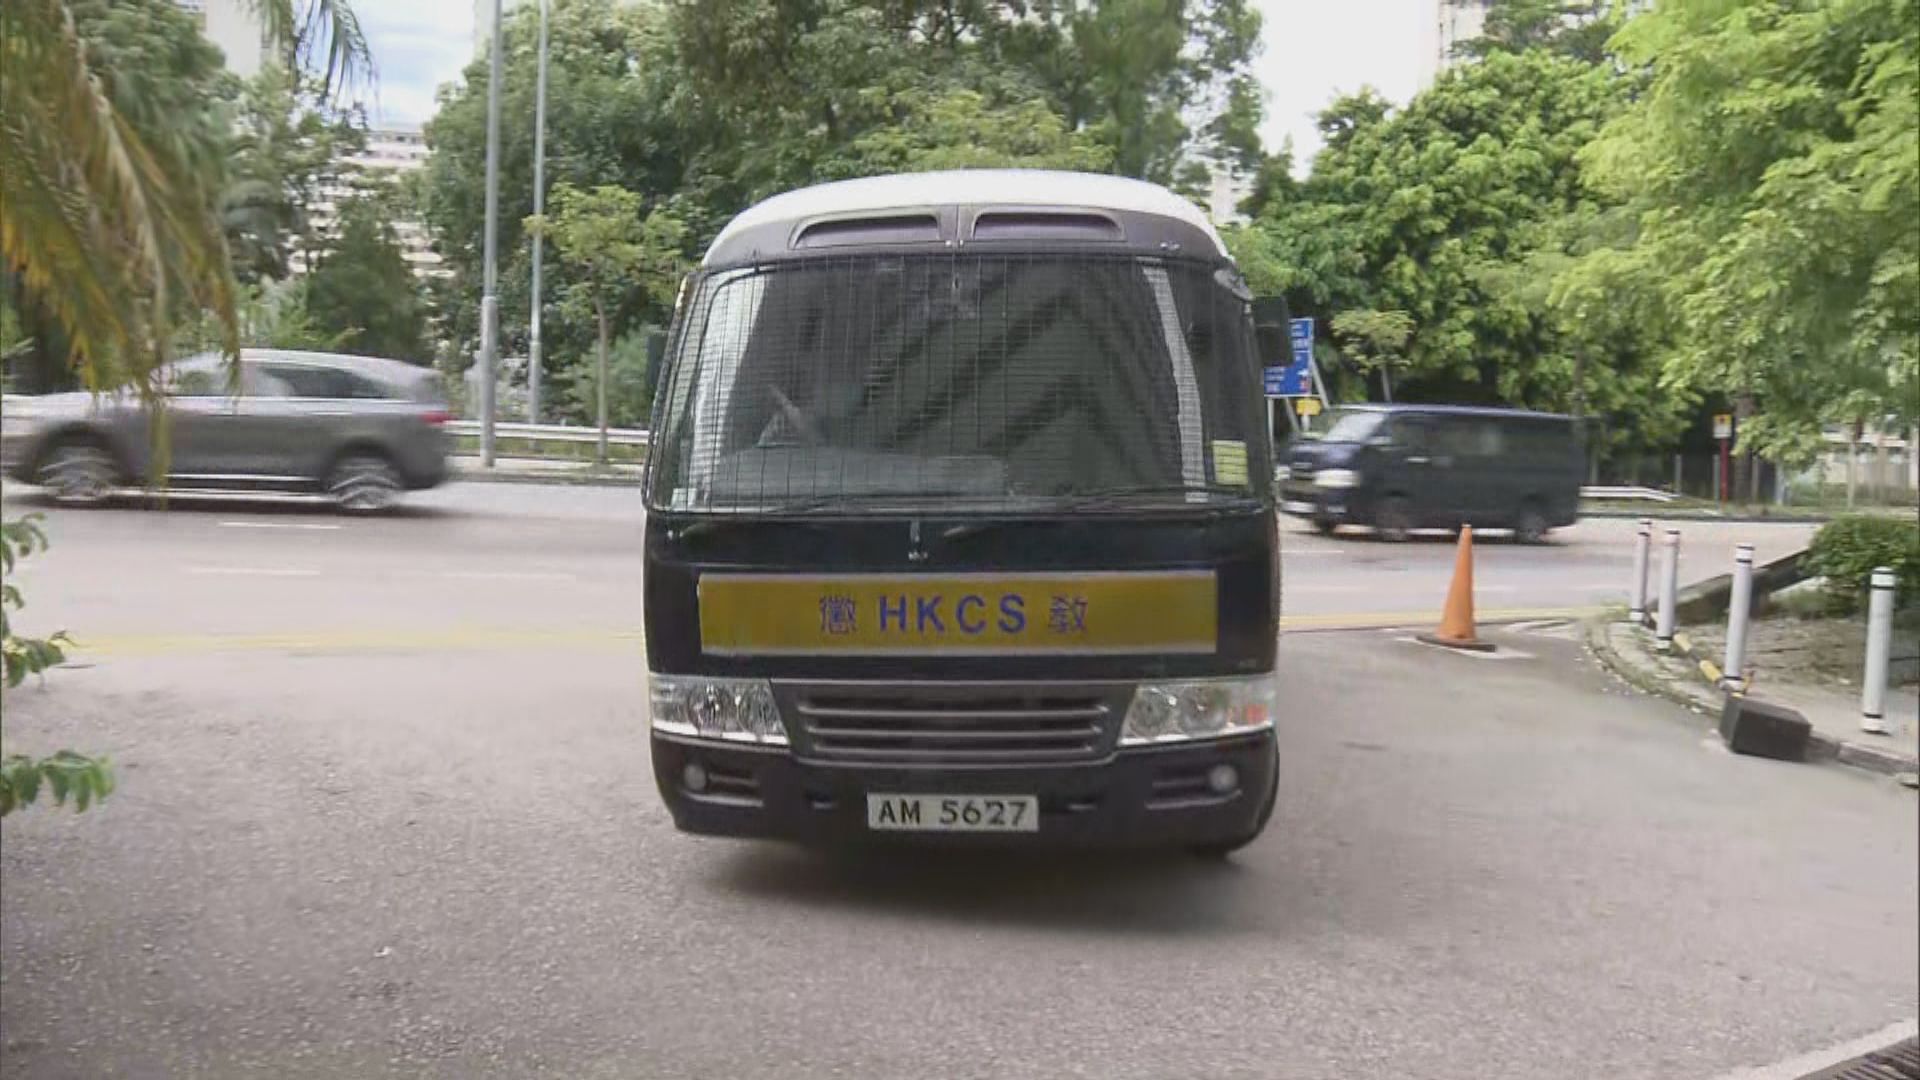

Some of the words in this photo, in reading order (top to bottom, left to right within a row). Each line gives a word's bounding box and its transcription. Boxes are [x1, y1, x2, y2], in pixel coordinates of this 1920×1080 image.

[819, 594, 857, 633] 懲
[879, 593, 1027, 634] HKCS
[878, 799, 921, 825] AM
[940, 800, 1028, 826] 5627
